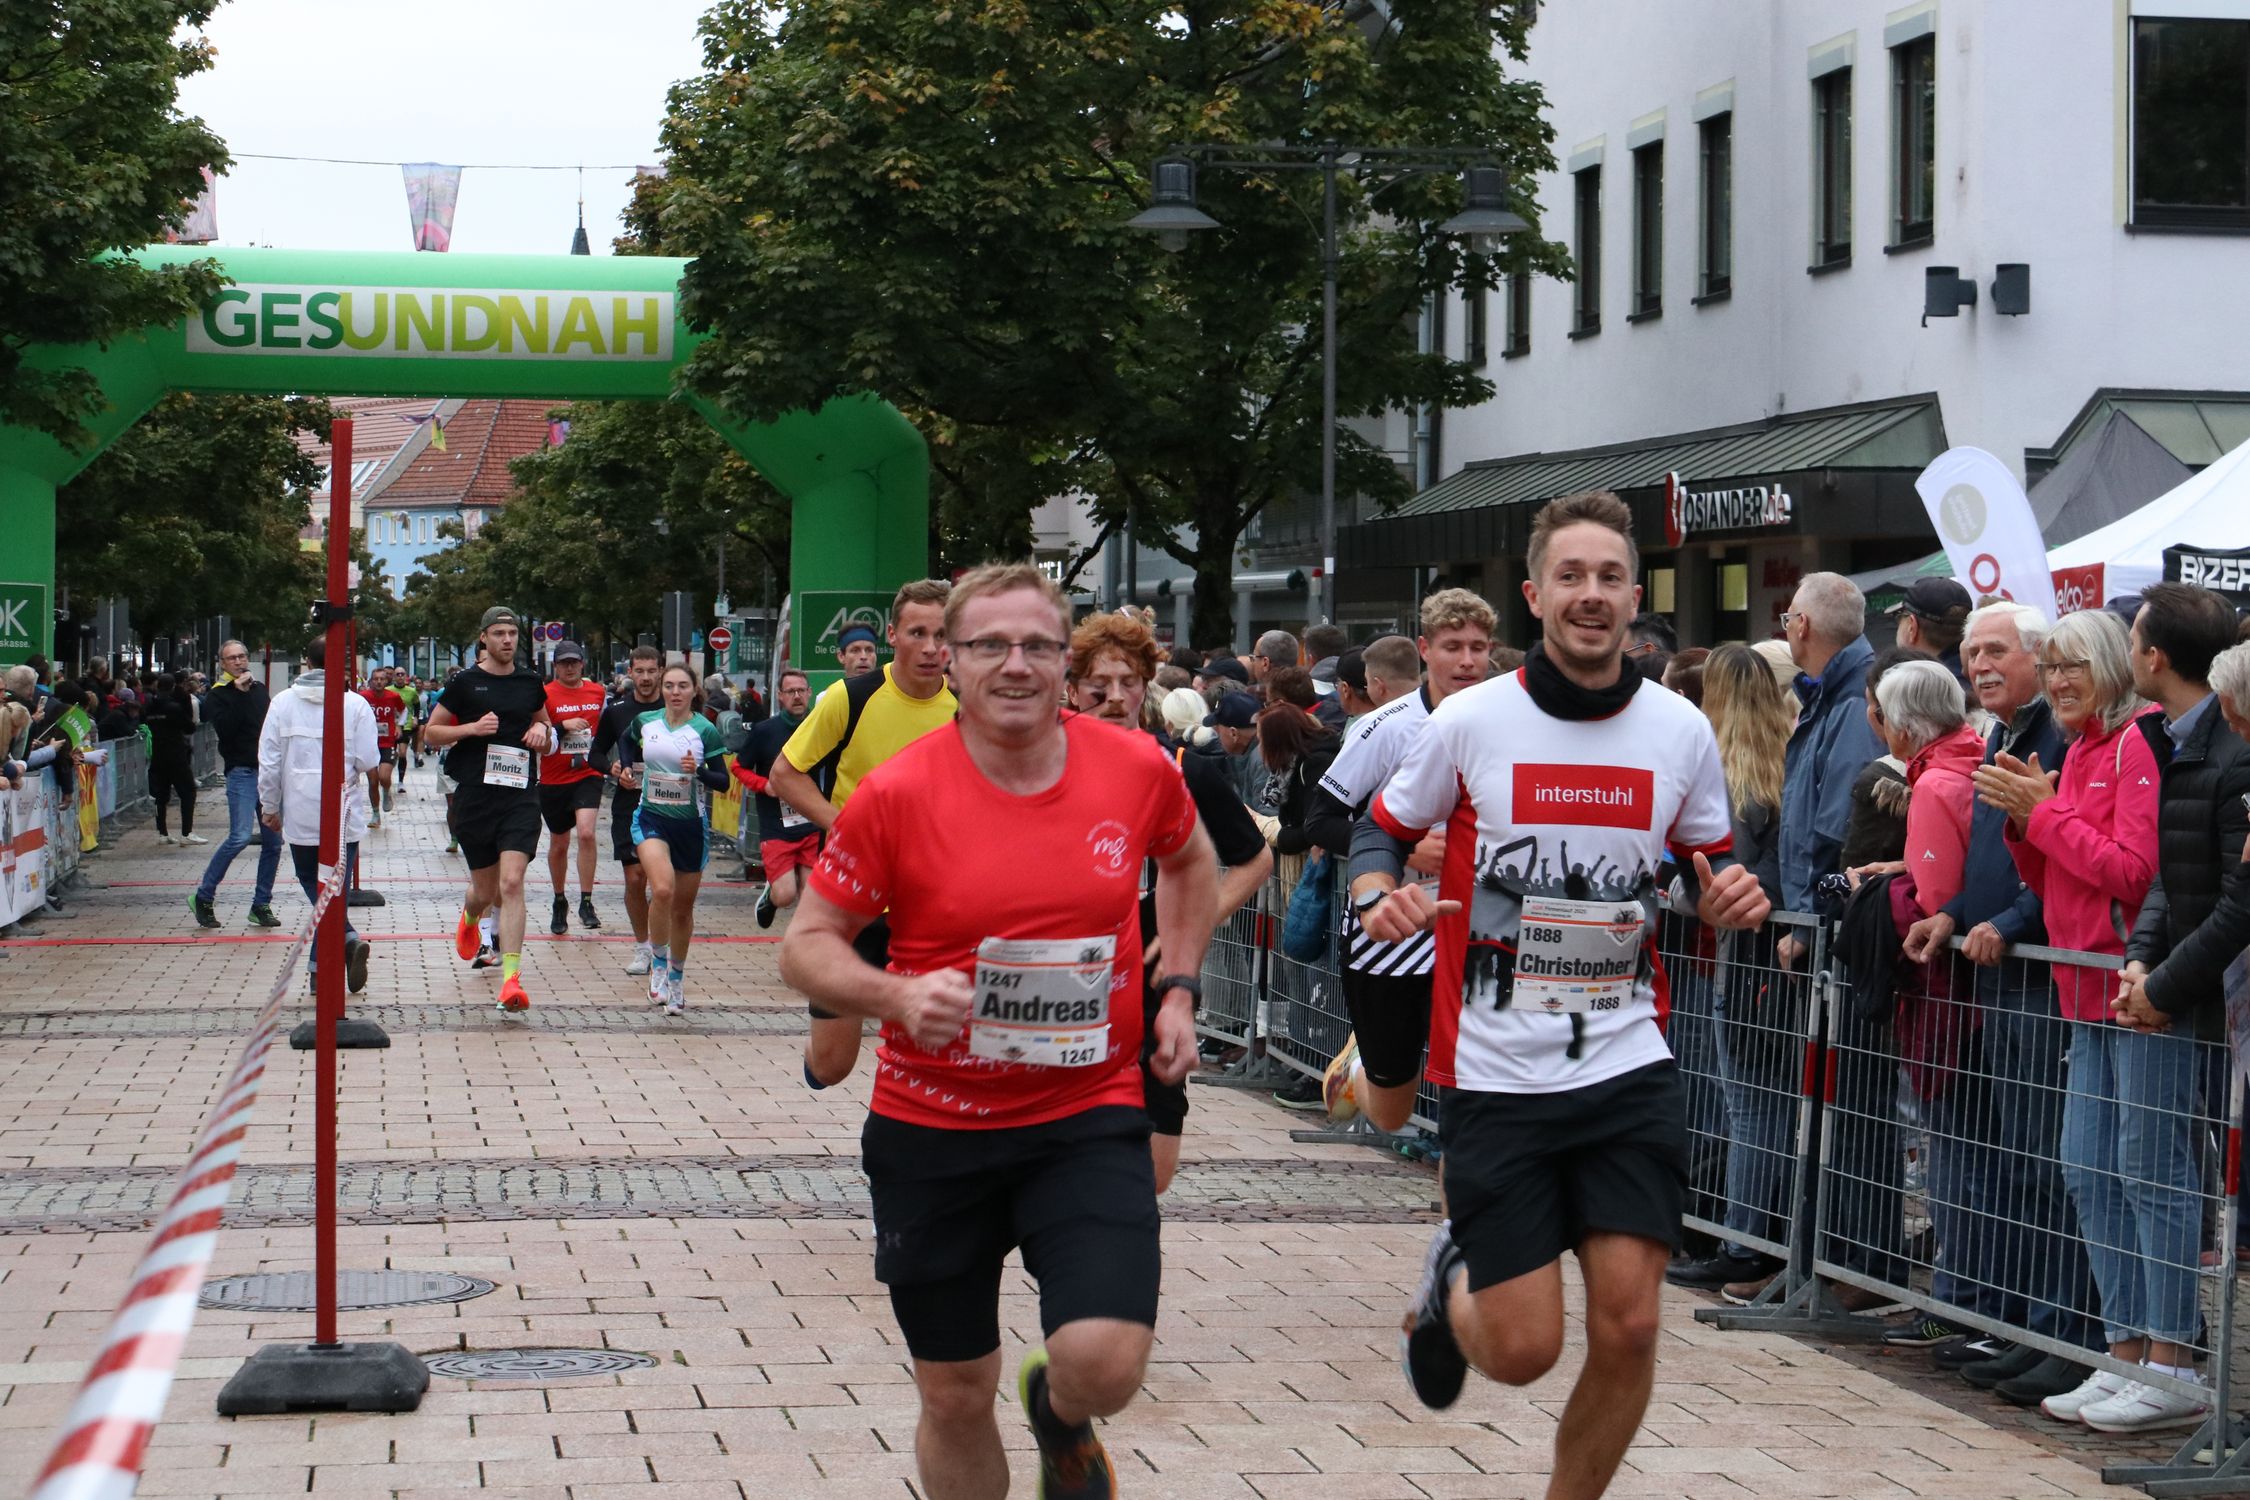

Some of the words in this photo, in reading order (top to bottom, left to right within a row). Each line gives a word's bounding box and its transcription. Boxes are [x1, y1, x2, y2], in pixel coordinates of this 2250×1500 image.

[203, 289, 659, 355] GESUNDNAH
[815, 645, 827, 654] Die
[1361, 702, 1409, 740] BIZERBA
[564, 741, 588, 749] Patrick
[492, 762, 522, 774] Moritz
[655, 788, 681, 799] Helen
[1535, 783, 1633, 806] interstuhl
[1524, 927, 1562, 943] 1888
[1520, 953, 1631, 980] Christopher
[980, 970, 1022, 989] 1247
[980, 992, 1100, 1022] Andreas
[1590, 997, 1620, 1010] 1888
[1060, 1047, 1096, 1064] 1247
